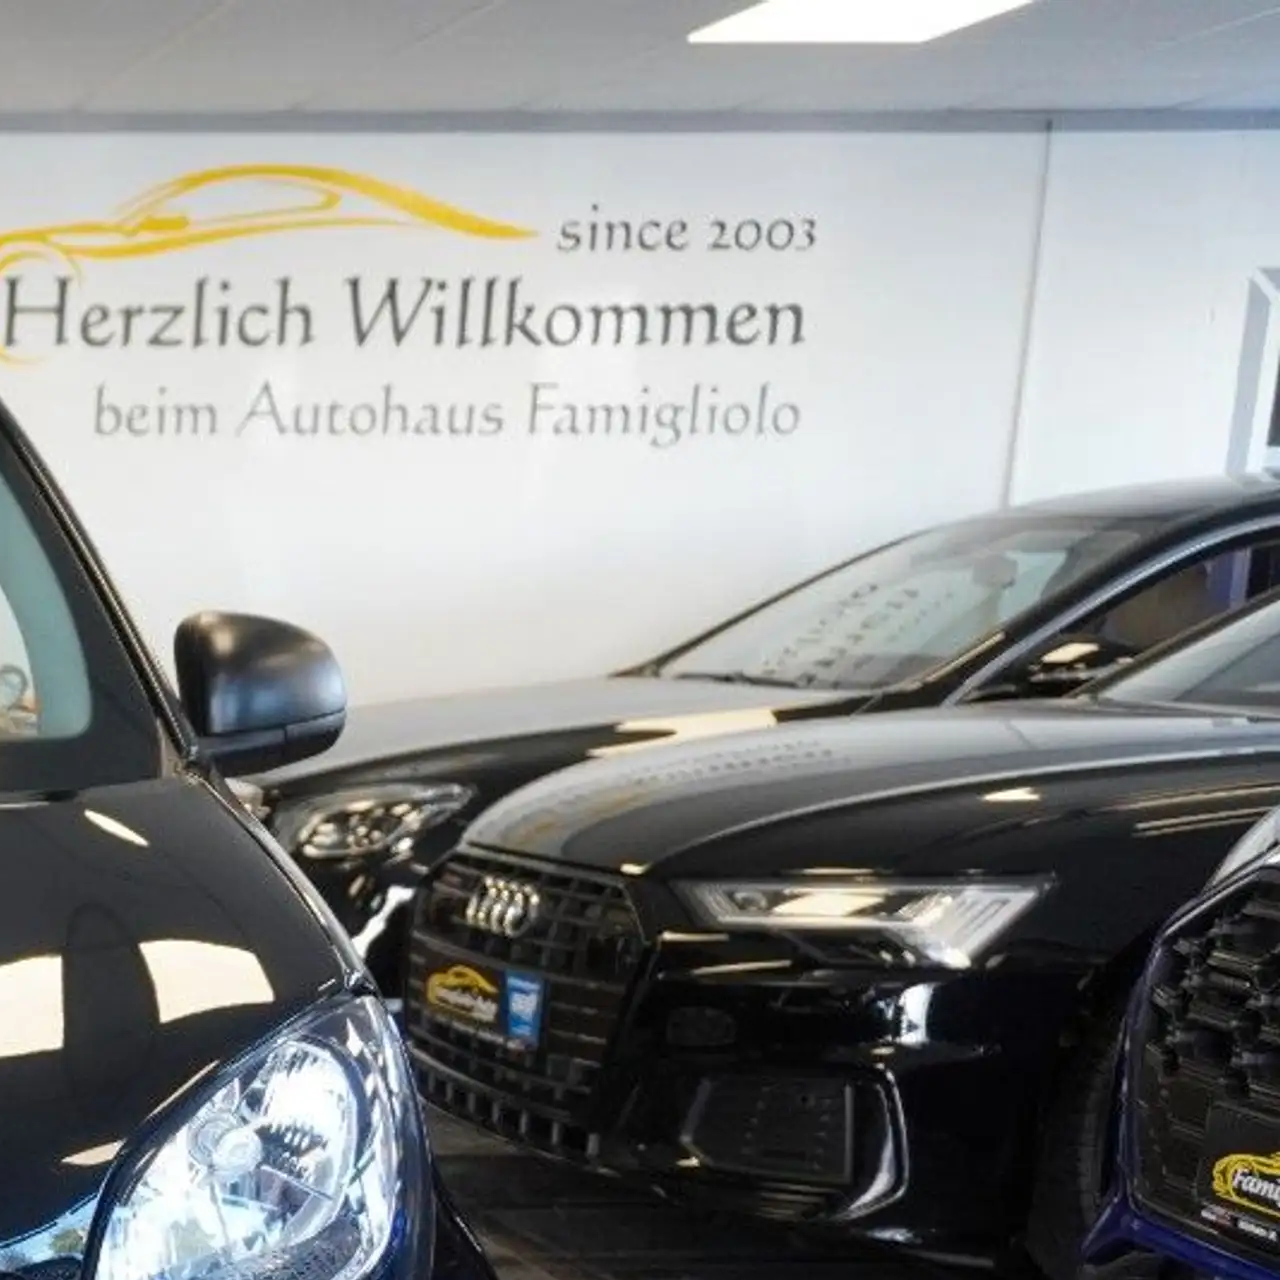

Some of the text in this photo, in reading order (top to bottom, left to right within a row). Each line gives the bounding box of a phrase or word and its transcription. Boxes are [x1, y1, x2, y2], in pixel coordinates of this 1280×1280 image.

[556, 203, 817, 252] since 2003
[3, 272, 806, 349] Herzlich Willkommen
[93, 379, 802, 448] beim Autohaus Famigliolo
